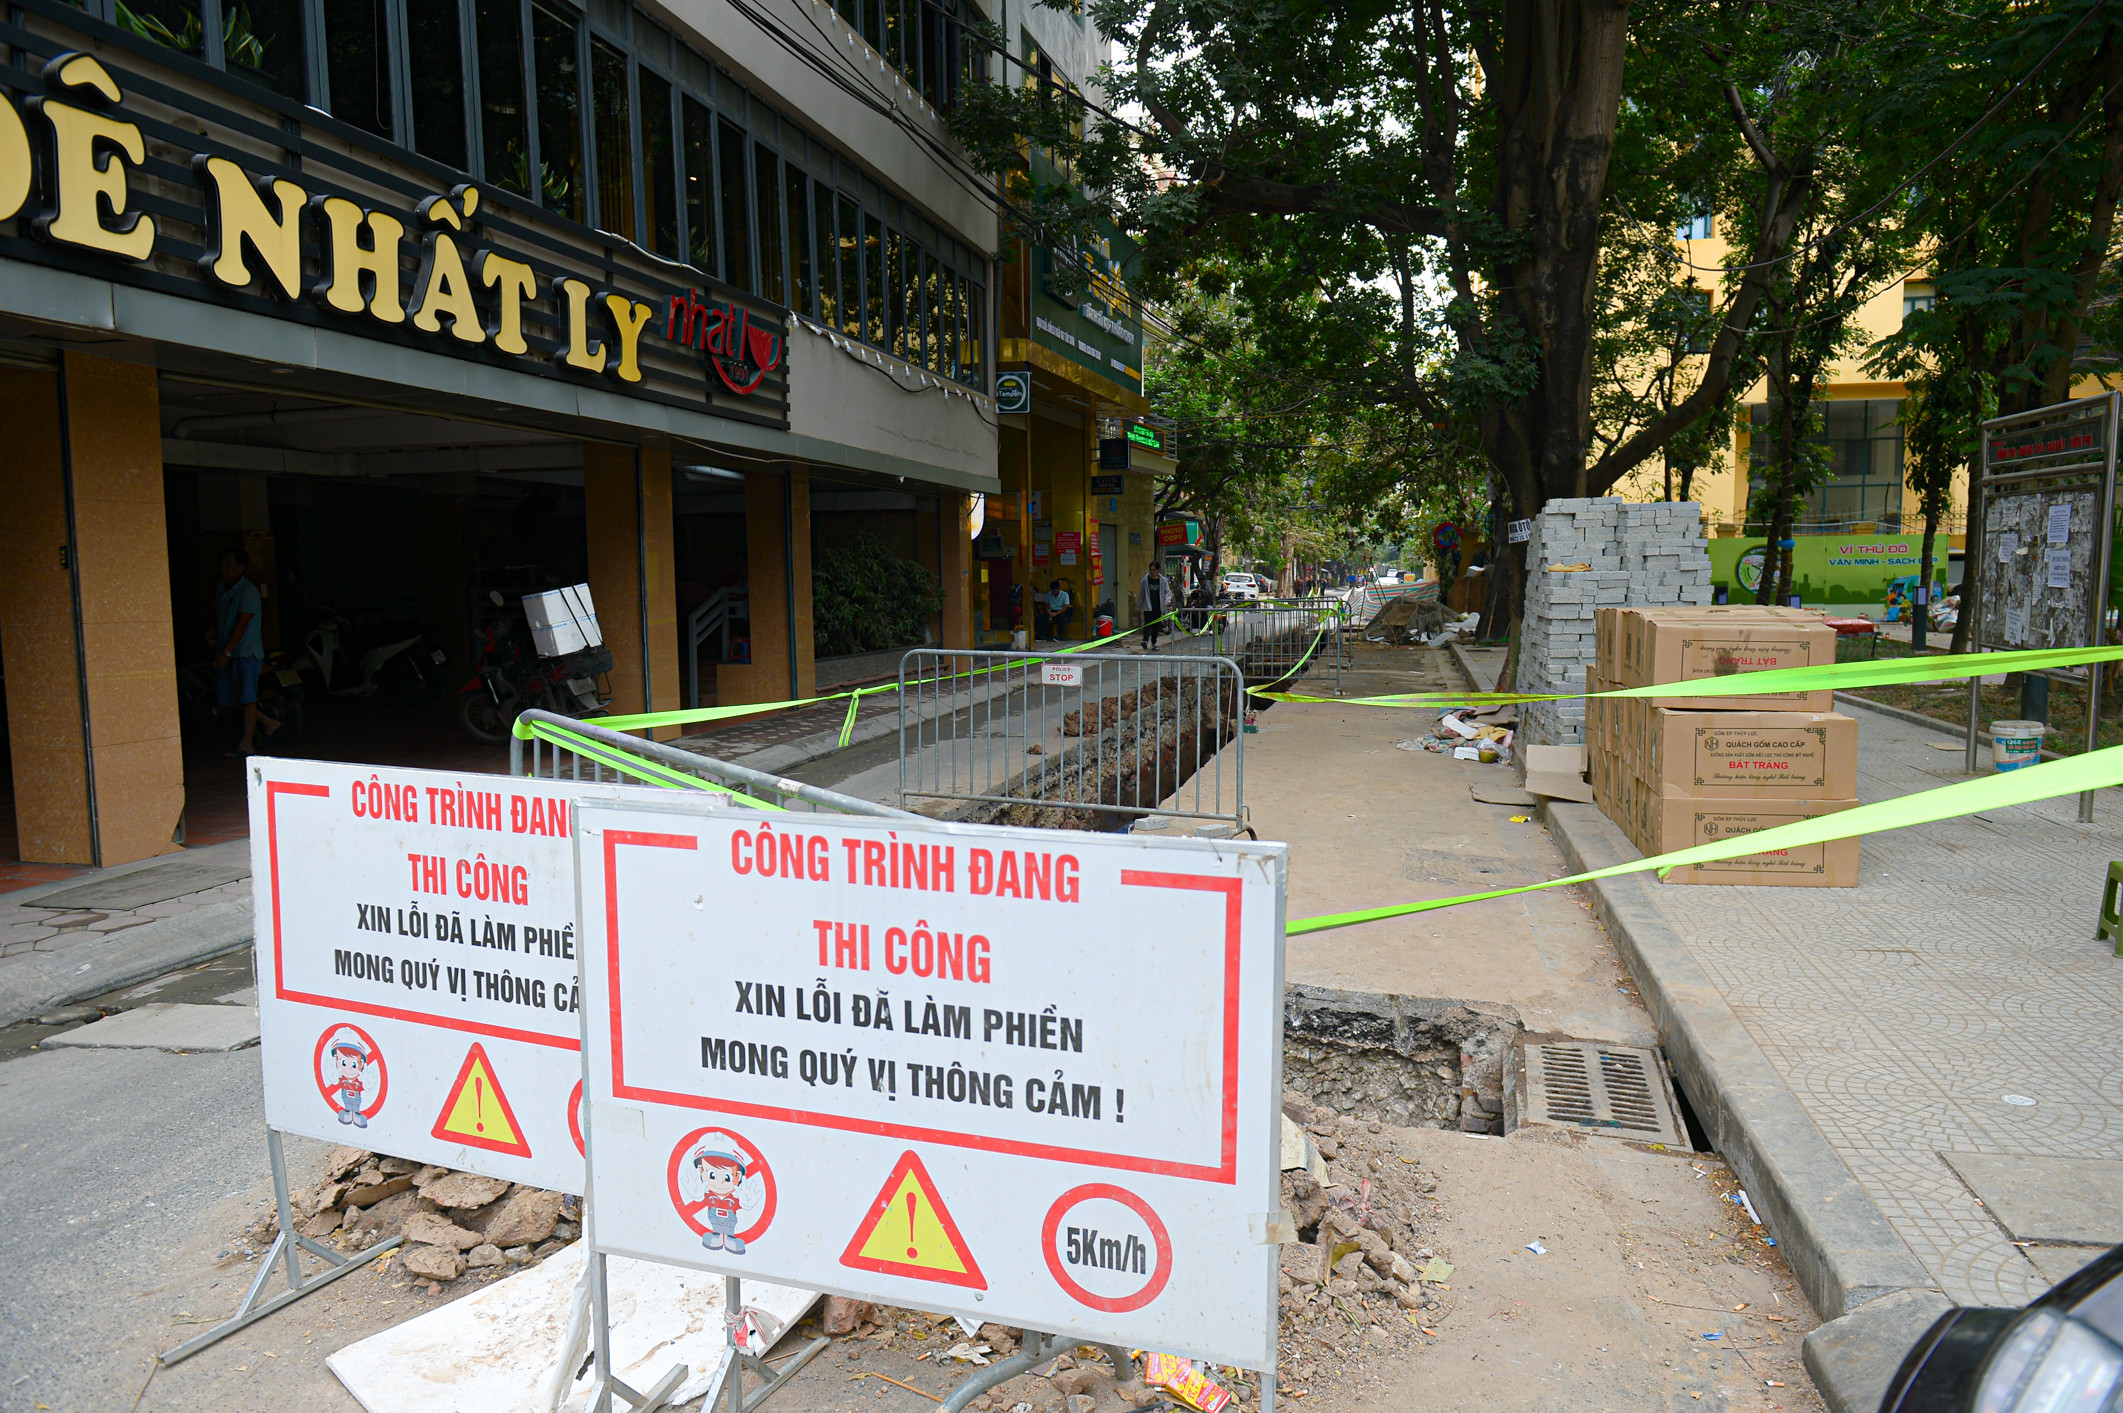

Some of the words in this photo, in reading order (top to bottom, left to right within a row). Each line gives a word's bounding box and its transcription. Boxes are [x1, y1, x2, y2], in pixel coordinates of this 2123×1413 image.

[202, 155, 537, 356] NHẤT
[560, 279, 652, 382] LY
[1160, 527, 1184, 536] PHOTO
[1163, 534, 1183, 542] COPY
[1857, 543, 1885, 554] THỦ
[1888, 543, 1908, 553] ĐÔ
[1050, 673, 1074, 681] STOP
[1756, 657, 1777, 667] BÁT
[1726, 739, 1752, 748] QUÁCH
[1753, 739, 1770, 748] GỐM
[1790, 739, 1806, 748] CẤP
[1729, 759, 1750, 769] BÁT
[1752, 759, 1789, 769] TRÀNG
[352, 773, 418, 823] CÔNG
[425, 787, 503, 832] TRÌNH
[510, 794, 575, 838] ĐAN
[1725, 826, 1751, 834] QUÁCH
[407, 853, 447, 895] THI
[456, 852, 528, 906] CÔNG
[731, 821, 830, 882] CÔNG
[842, 831, 955, 893] TRÌNH
[968, 847, 1079, 903] ĐANG
[356, 903, 391, 934] XIN
[397, 908, 429, 939] LỖI
[435, 913, 464, 944] ĐÃ
[470, 918, 516, 952] LÀM
[523, 925, 575, 960] PHIỀ
[813, 919, 871, 971] THI
[885, 919, 991, 984] CÔNG
[334, 949, 394, 984] MONG
[400, 959, 440, 991] QUÝ
[446, 966, 467, 996] VỊ
[473, 970, 546, 1009] THÔNG
[553, 975, 580, 1013] CẢ
[735, 980, 785, 1018] XIN
[796, 977, 841, 1024] LỖI
[851, 990, 894, 1031] ĐÃ
[904, 995, 971, 1040] LÀM
[984, 1007, 1083, 1053] PHIỀN
[701, 1036, 788, 1079] MONG
[799, 1047, 858, 1088] QUÝ
[867, 1058, 896, 1101] VỊ
[907, 1061, 1013, 1109] THÔNG
[1026, 1069, 1101, 1120] CẢM
[1116, 1088, 1124, 1123] !
[1066, 1226, 1146, 1275] 5Km/h
